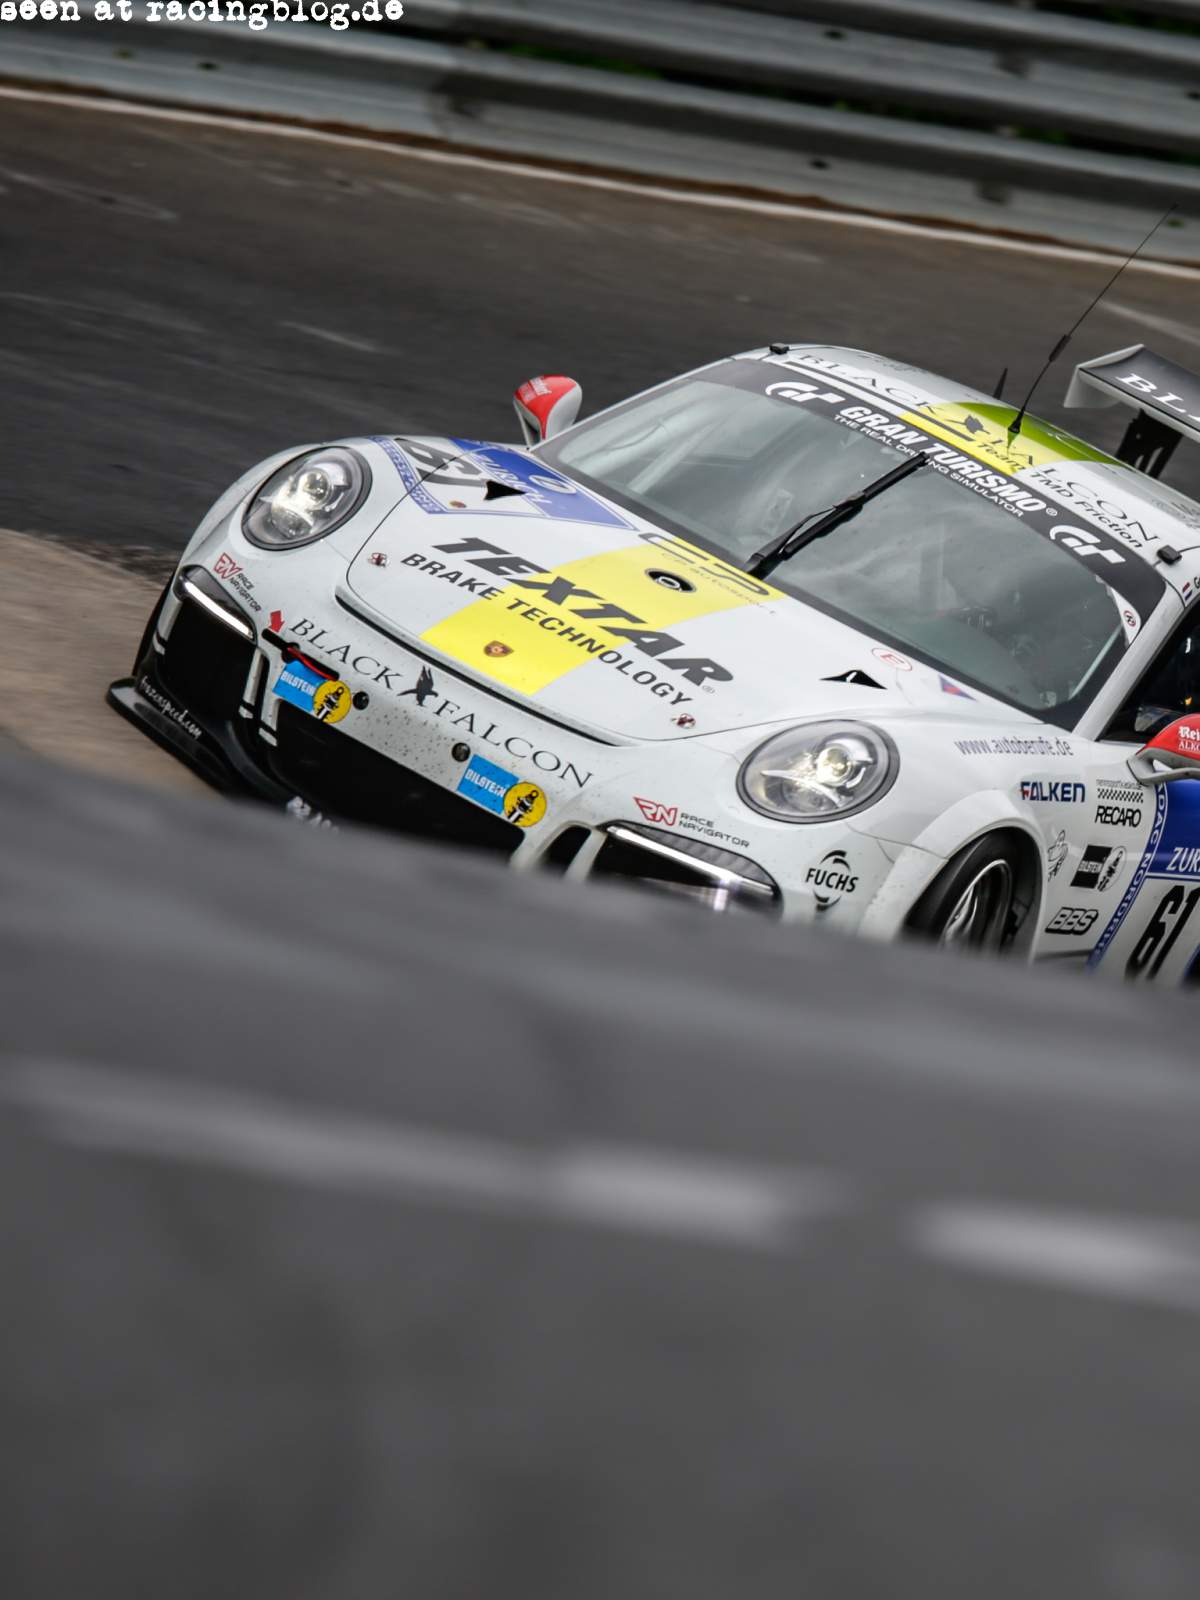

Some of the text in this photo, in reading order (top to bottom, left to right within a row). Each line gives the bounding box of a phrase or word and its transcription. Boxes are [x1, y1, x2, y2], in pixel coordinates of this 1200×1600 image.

[840, 406, 929, 444] GRAN
[834, 414, 1025, 518] THE REAL DRIING SIMULATOR
[977, 443, 1026, 471] Team
[1030, 471, 1074, 497] TMD
[1076, 501, 1144, 548] Friction
[229, 577, 263, 613] NAVIGATOR
[237, 572, 256, 590] RACE
[432, 536, 735, 687] TEXTAR
[400, 553, 695, 708] BRAKE TECHNOLOGY
[281, 671, 316, 696] BILSTEIN
[289, 618, 594, 789] BLACK FALCON
[465, 768, 507, 798] BILSTEIN
[1020, 781, 1086, 803] FALKEN
[681, 812, 714, 827] RACE
[1094, 805, 1142, 828] RECARO
[679, 820, 750, 848] NAVIGATOR
[805, 867, 859, 893] FUCHS
[1045, 907, 1099, 936] BBS
